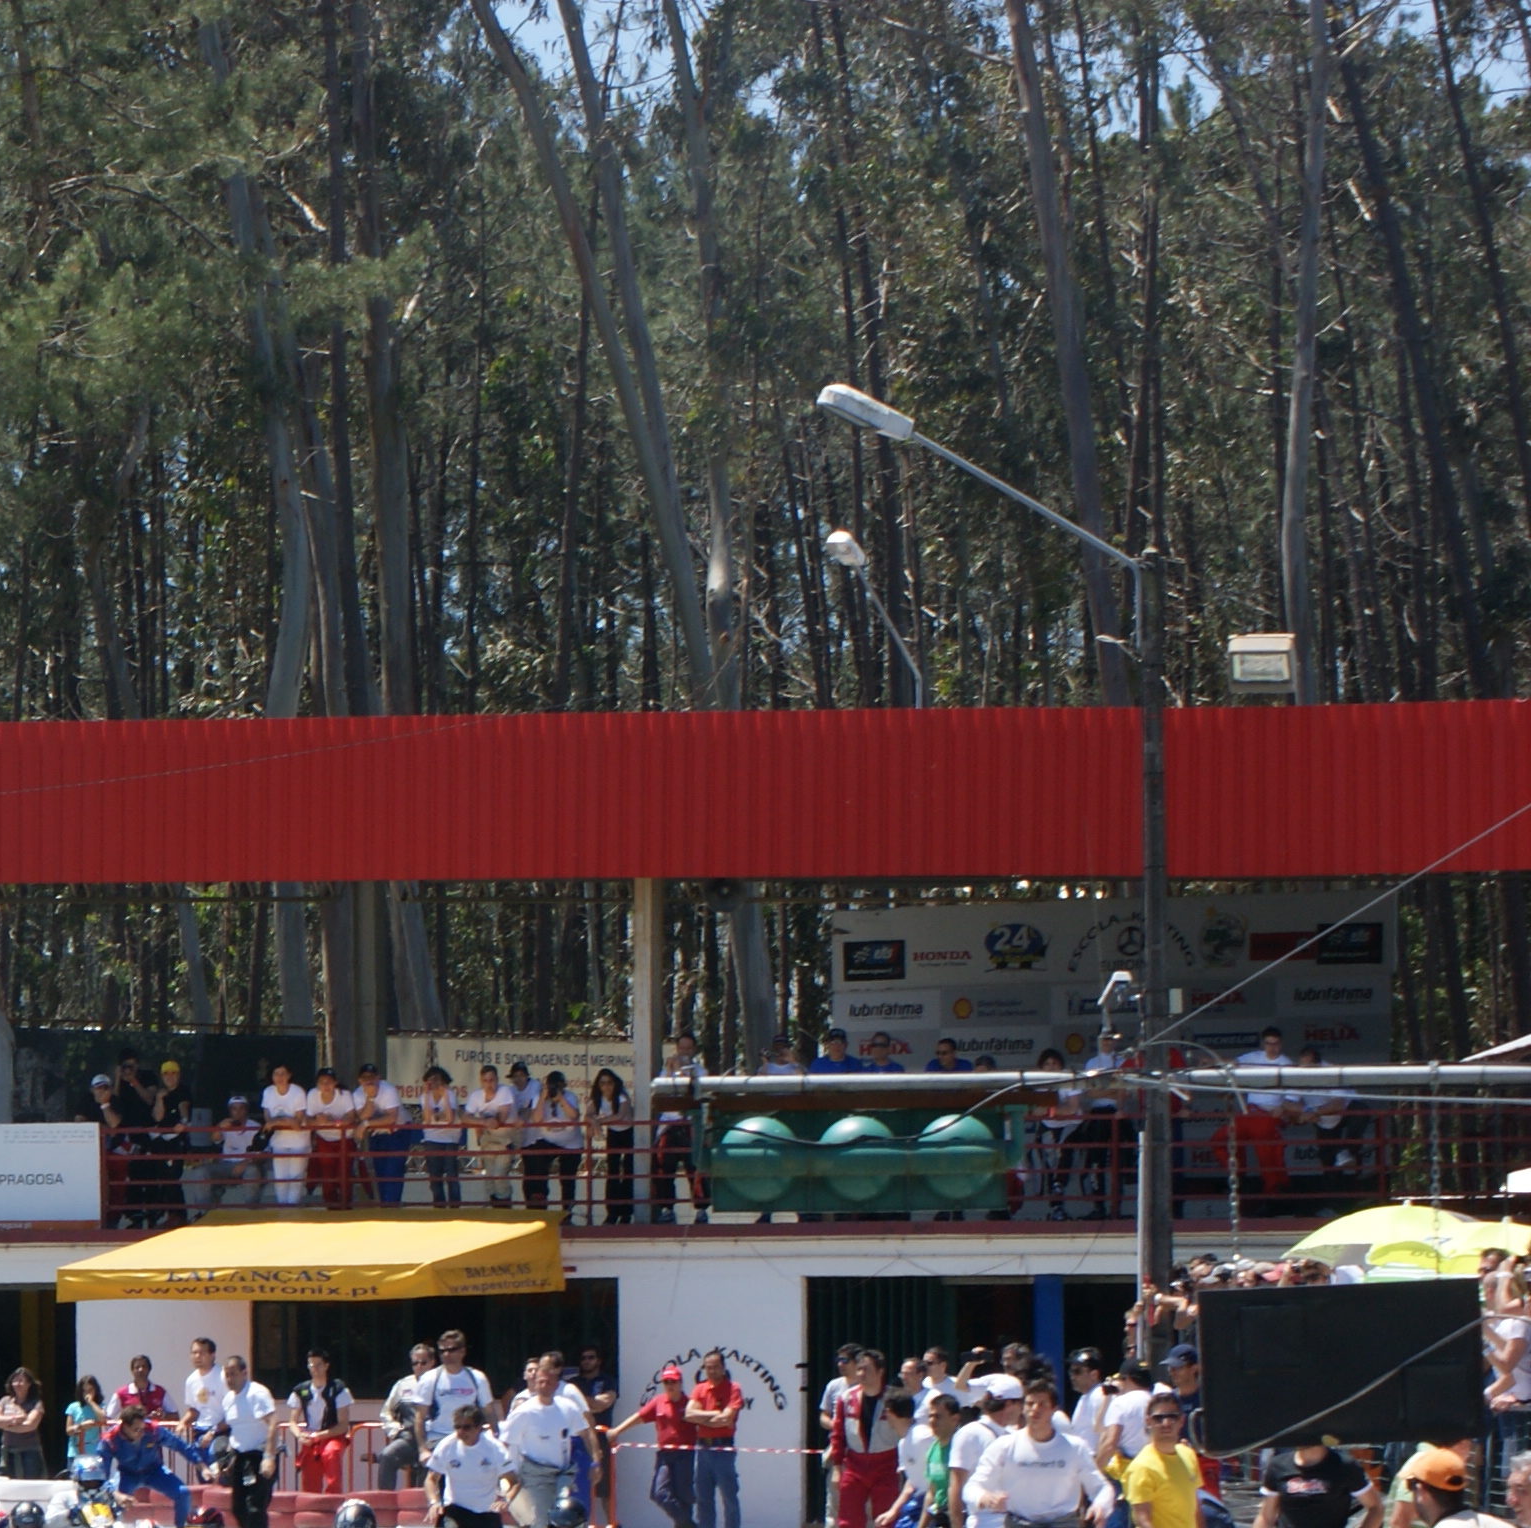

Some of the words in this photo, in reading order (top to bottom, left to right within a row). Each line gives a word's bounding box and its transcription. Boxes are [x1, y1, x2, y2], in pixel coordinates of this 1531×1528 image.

[993, 926, 1031, 951] 24
[912, 950, 972, 961] HONDA
[1304, 1027, 1359, 1041] HELIX
[455, 1050, 492, 1063] FUROS
[494, 1052, 502, 1063] E
[573, 1053, 587, 1066] DE
[122, 1284, 379, 1298] www.pestronix.pt
